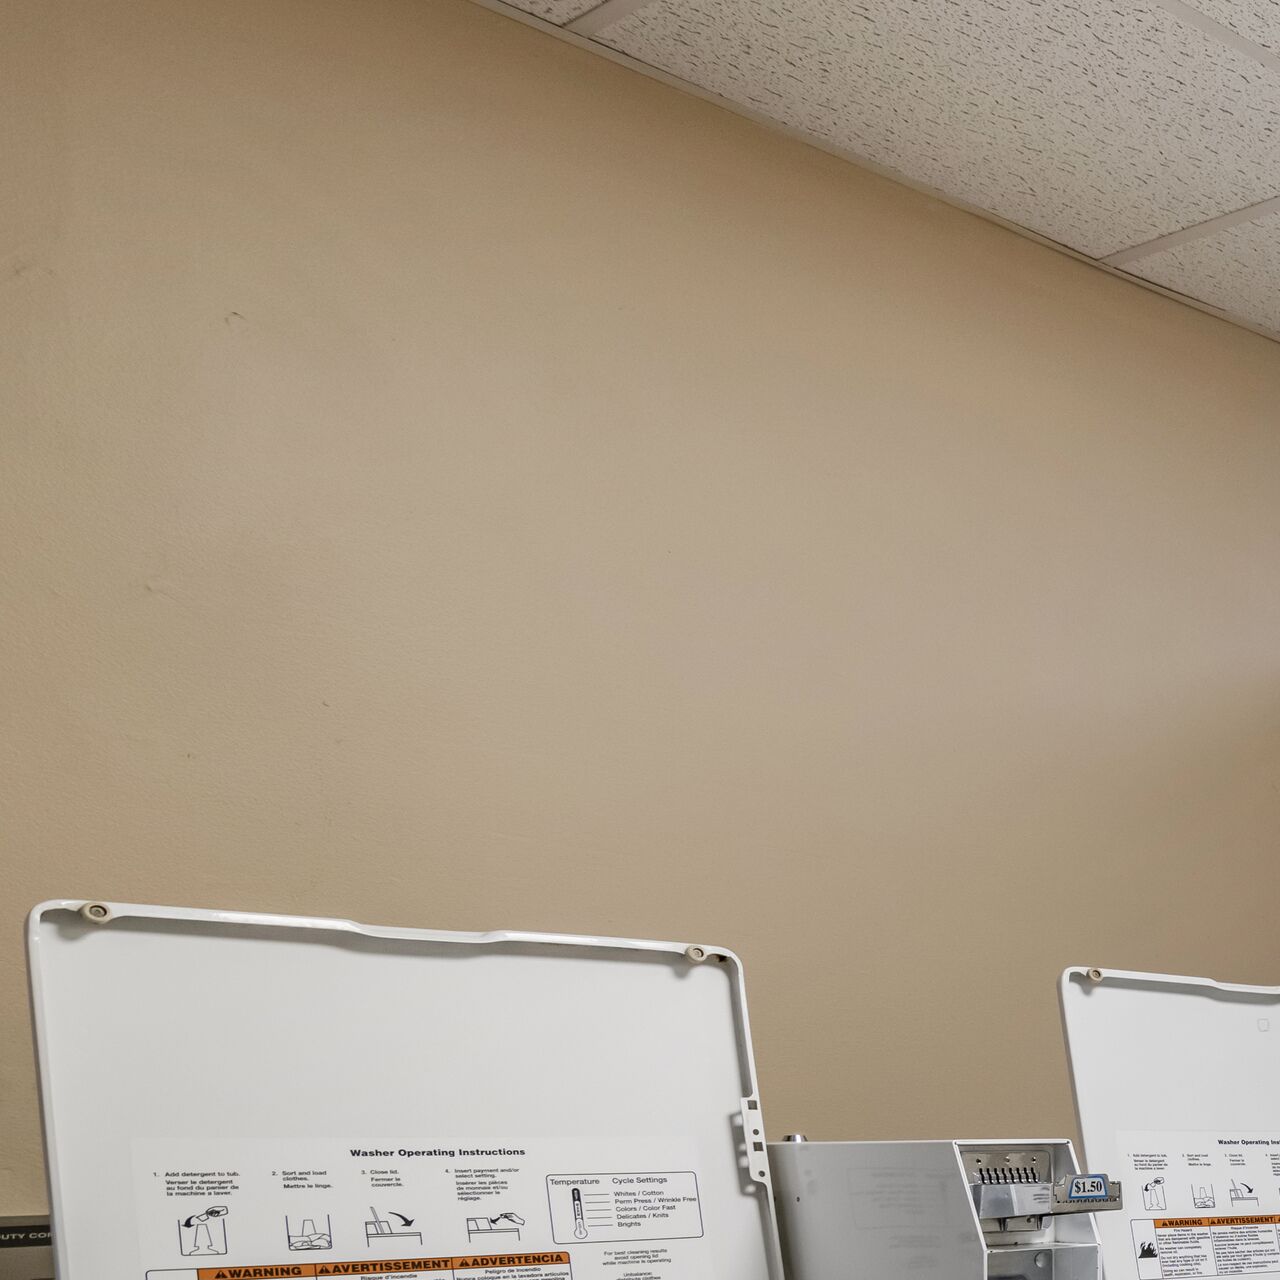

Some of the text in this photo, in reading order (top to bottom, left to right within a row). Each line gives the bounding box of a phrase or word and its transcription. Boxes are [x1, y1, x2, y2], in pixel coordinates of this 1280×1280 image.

[350, 1149, 394, 1157] Washer
[398, 1149, 455, 1158] Operating
[549, 1178, 600, 1186] Temperature
[611, 1176, 668, 1185] Cycle Settings
[1075, 1181, 1102, 1193] $1.50
[1168, 1218, 1203, 1227] WARNING
[1217, 1216, 1273, 1224] AVERTISSEMENT
[472, 1254, 564, 1266] ADVERTENCIA
[332, 1260, 450, 1273] AVERTISSEMENT
[228, 1266, 302, 1279] WARNING
